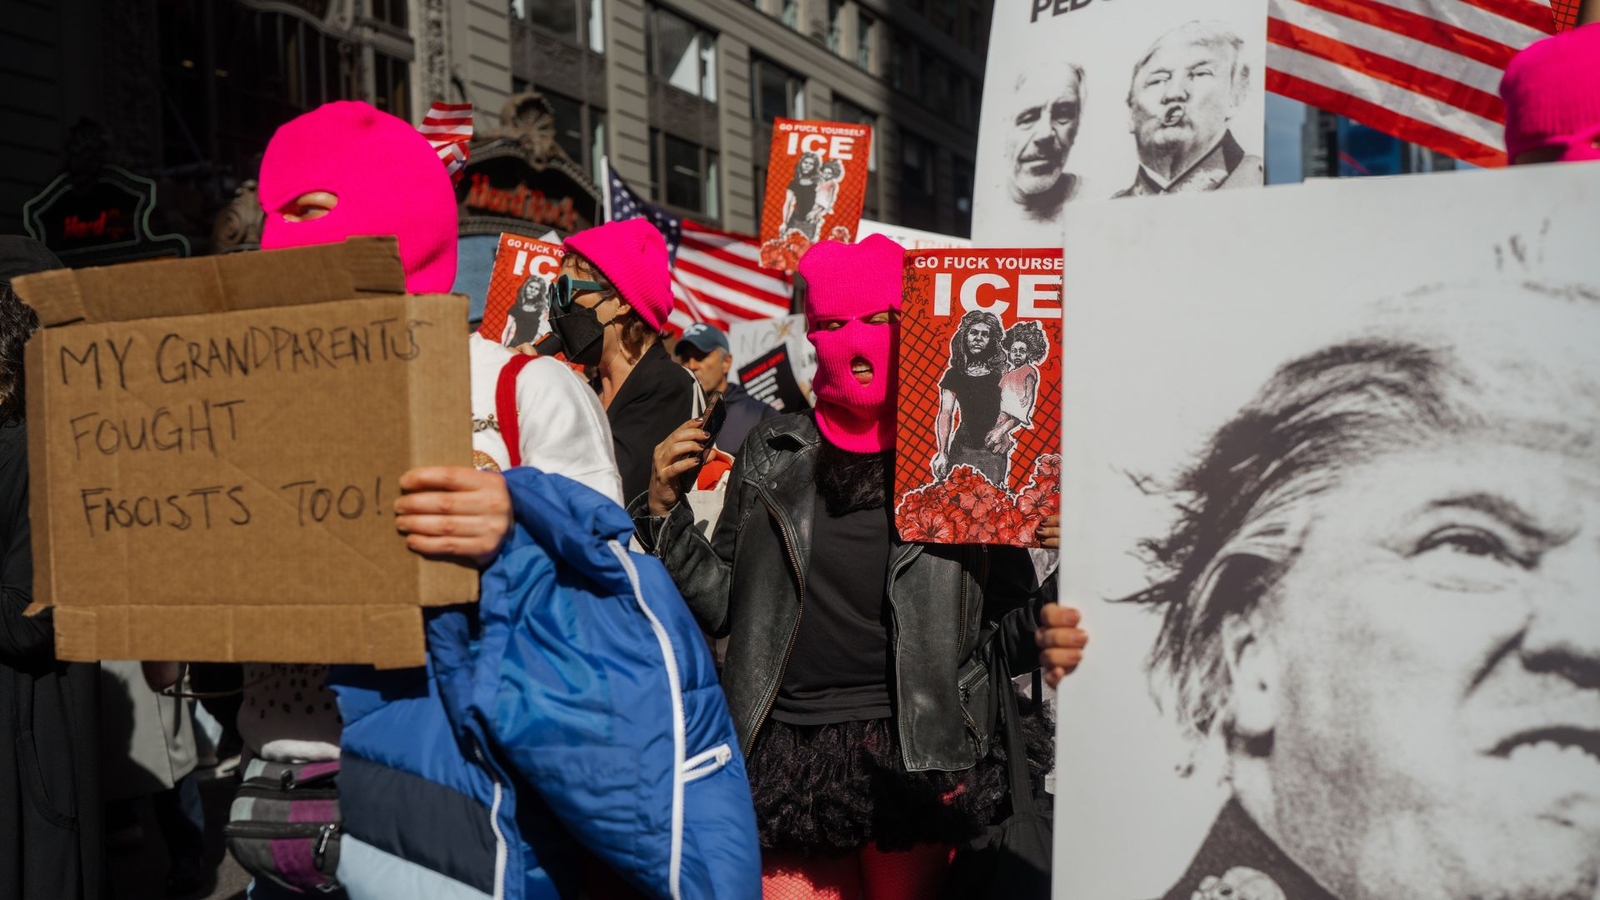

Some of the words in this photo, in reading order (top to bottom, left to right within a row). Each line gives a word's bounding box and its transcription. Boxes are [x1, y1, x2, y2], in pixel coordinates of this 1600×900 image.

[779, 123, 793, 131] GO
[794, 124, 819, 133] FUCK
[786, 132, 855, 160] ICE
[507, 239, 522, 248] GO
[524, 242, 550, 255] FUCK
[513, 250, 560, 280] IC
[914, 256, 939, 269] GO
[944, 257, 989, 269] FUCK
[995, 257, 1064, 270] YOURSE
[934, 273, 1063, 318] ICE
[60, 336, 134, 391] MY
[69, 399, 246, 461] FOUGHT
[81, 485, 252, 538] FASCISTS
[280, 476, 383, 527] TOO!
